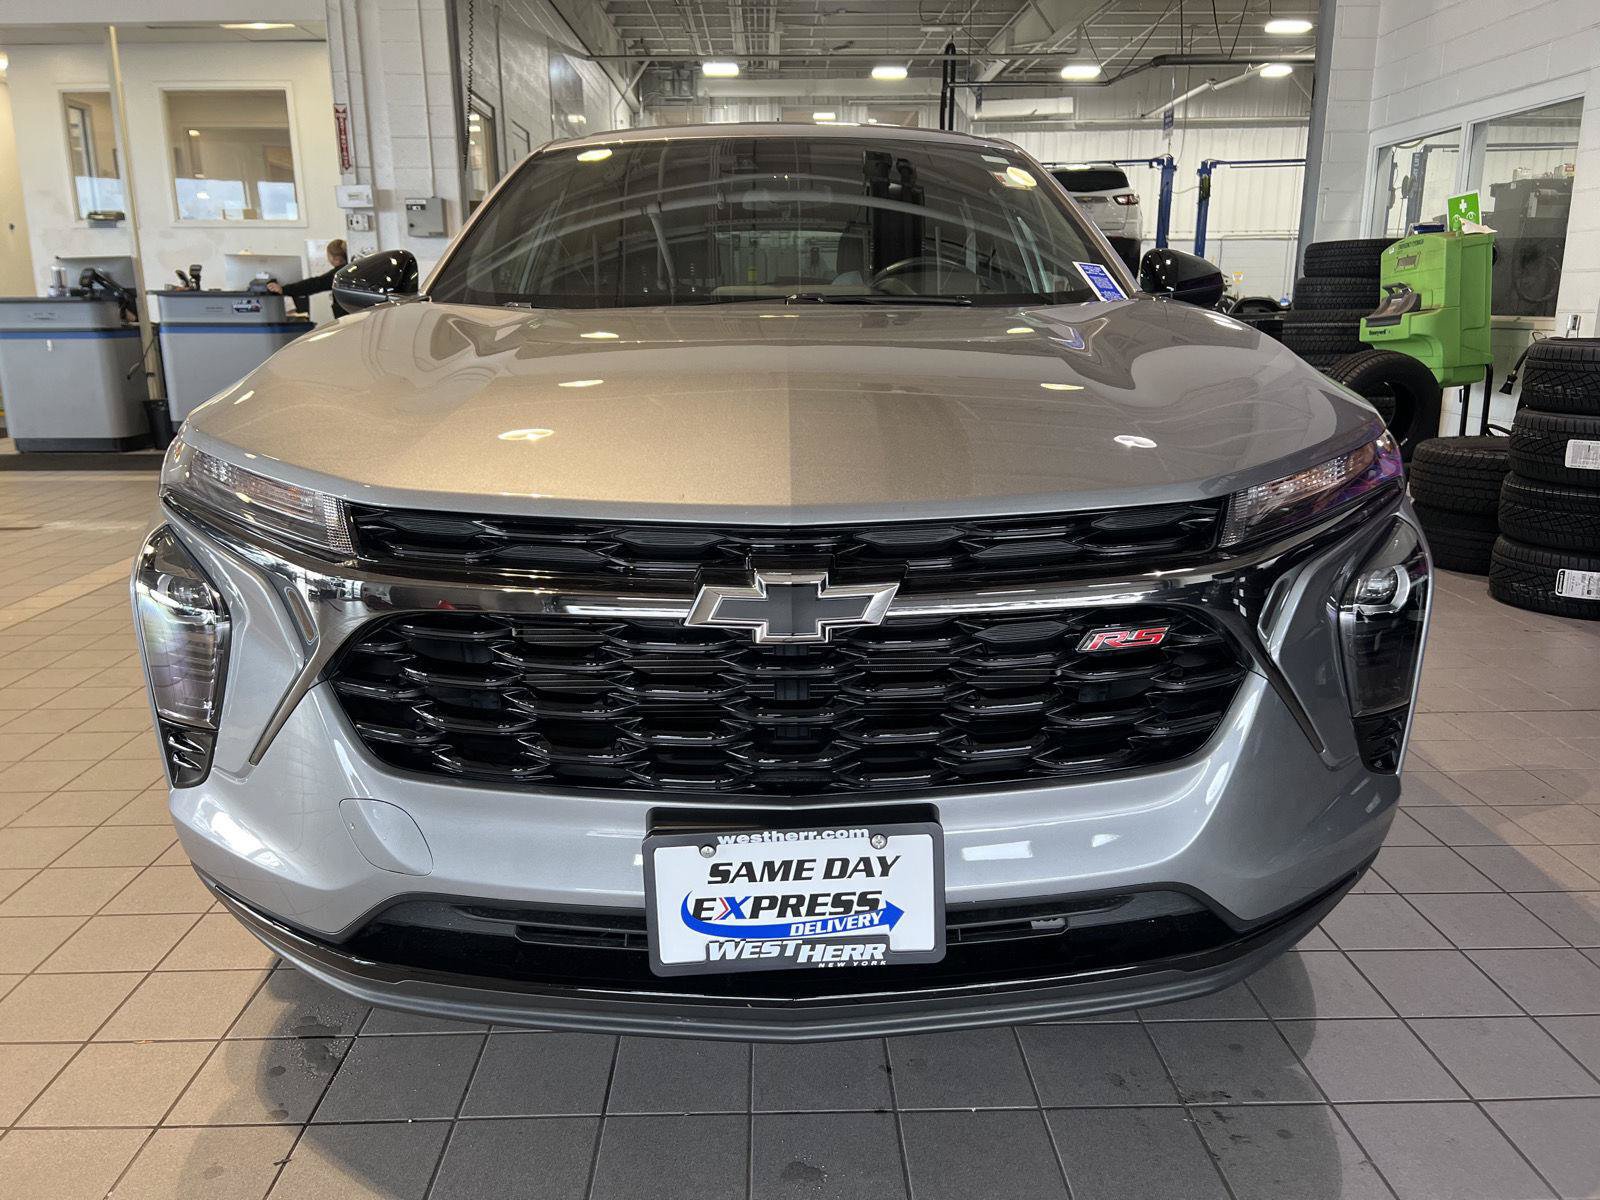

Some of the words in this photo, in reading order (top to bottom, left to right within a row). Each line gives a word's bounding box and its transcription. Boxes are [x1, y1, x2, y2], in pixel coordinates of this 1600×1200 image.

[1081, 627, 1168, 651] RS
[717, 827, 869, 845] westherr.com
[707, 859, 817, 885] SAME
[822, 855, 902, 880] DAY
[692, 890, 882, 921] EXPRESS
[789, 911, 884, 937] DELIVERY
